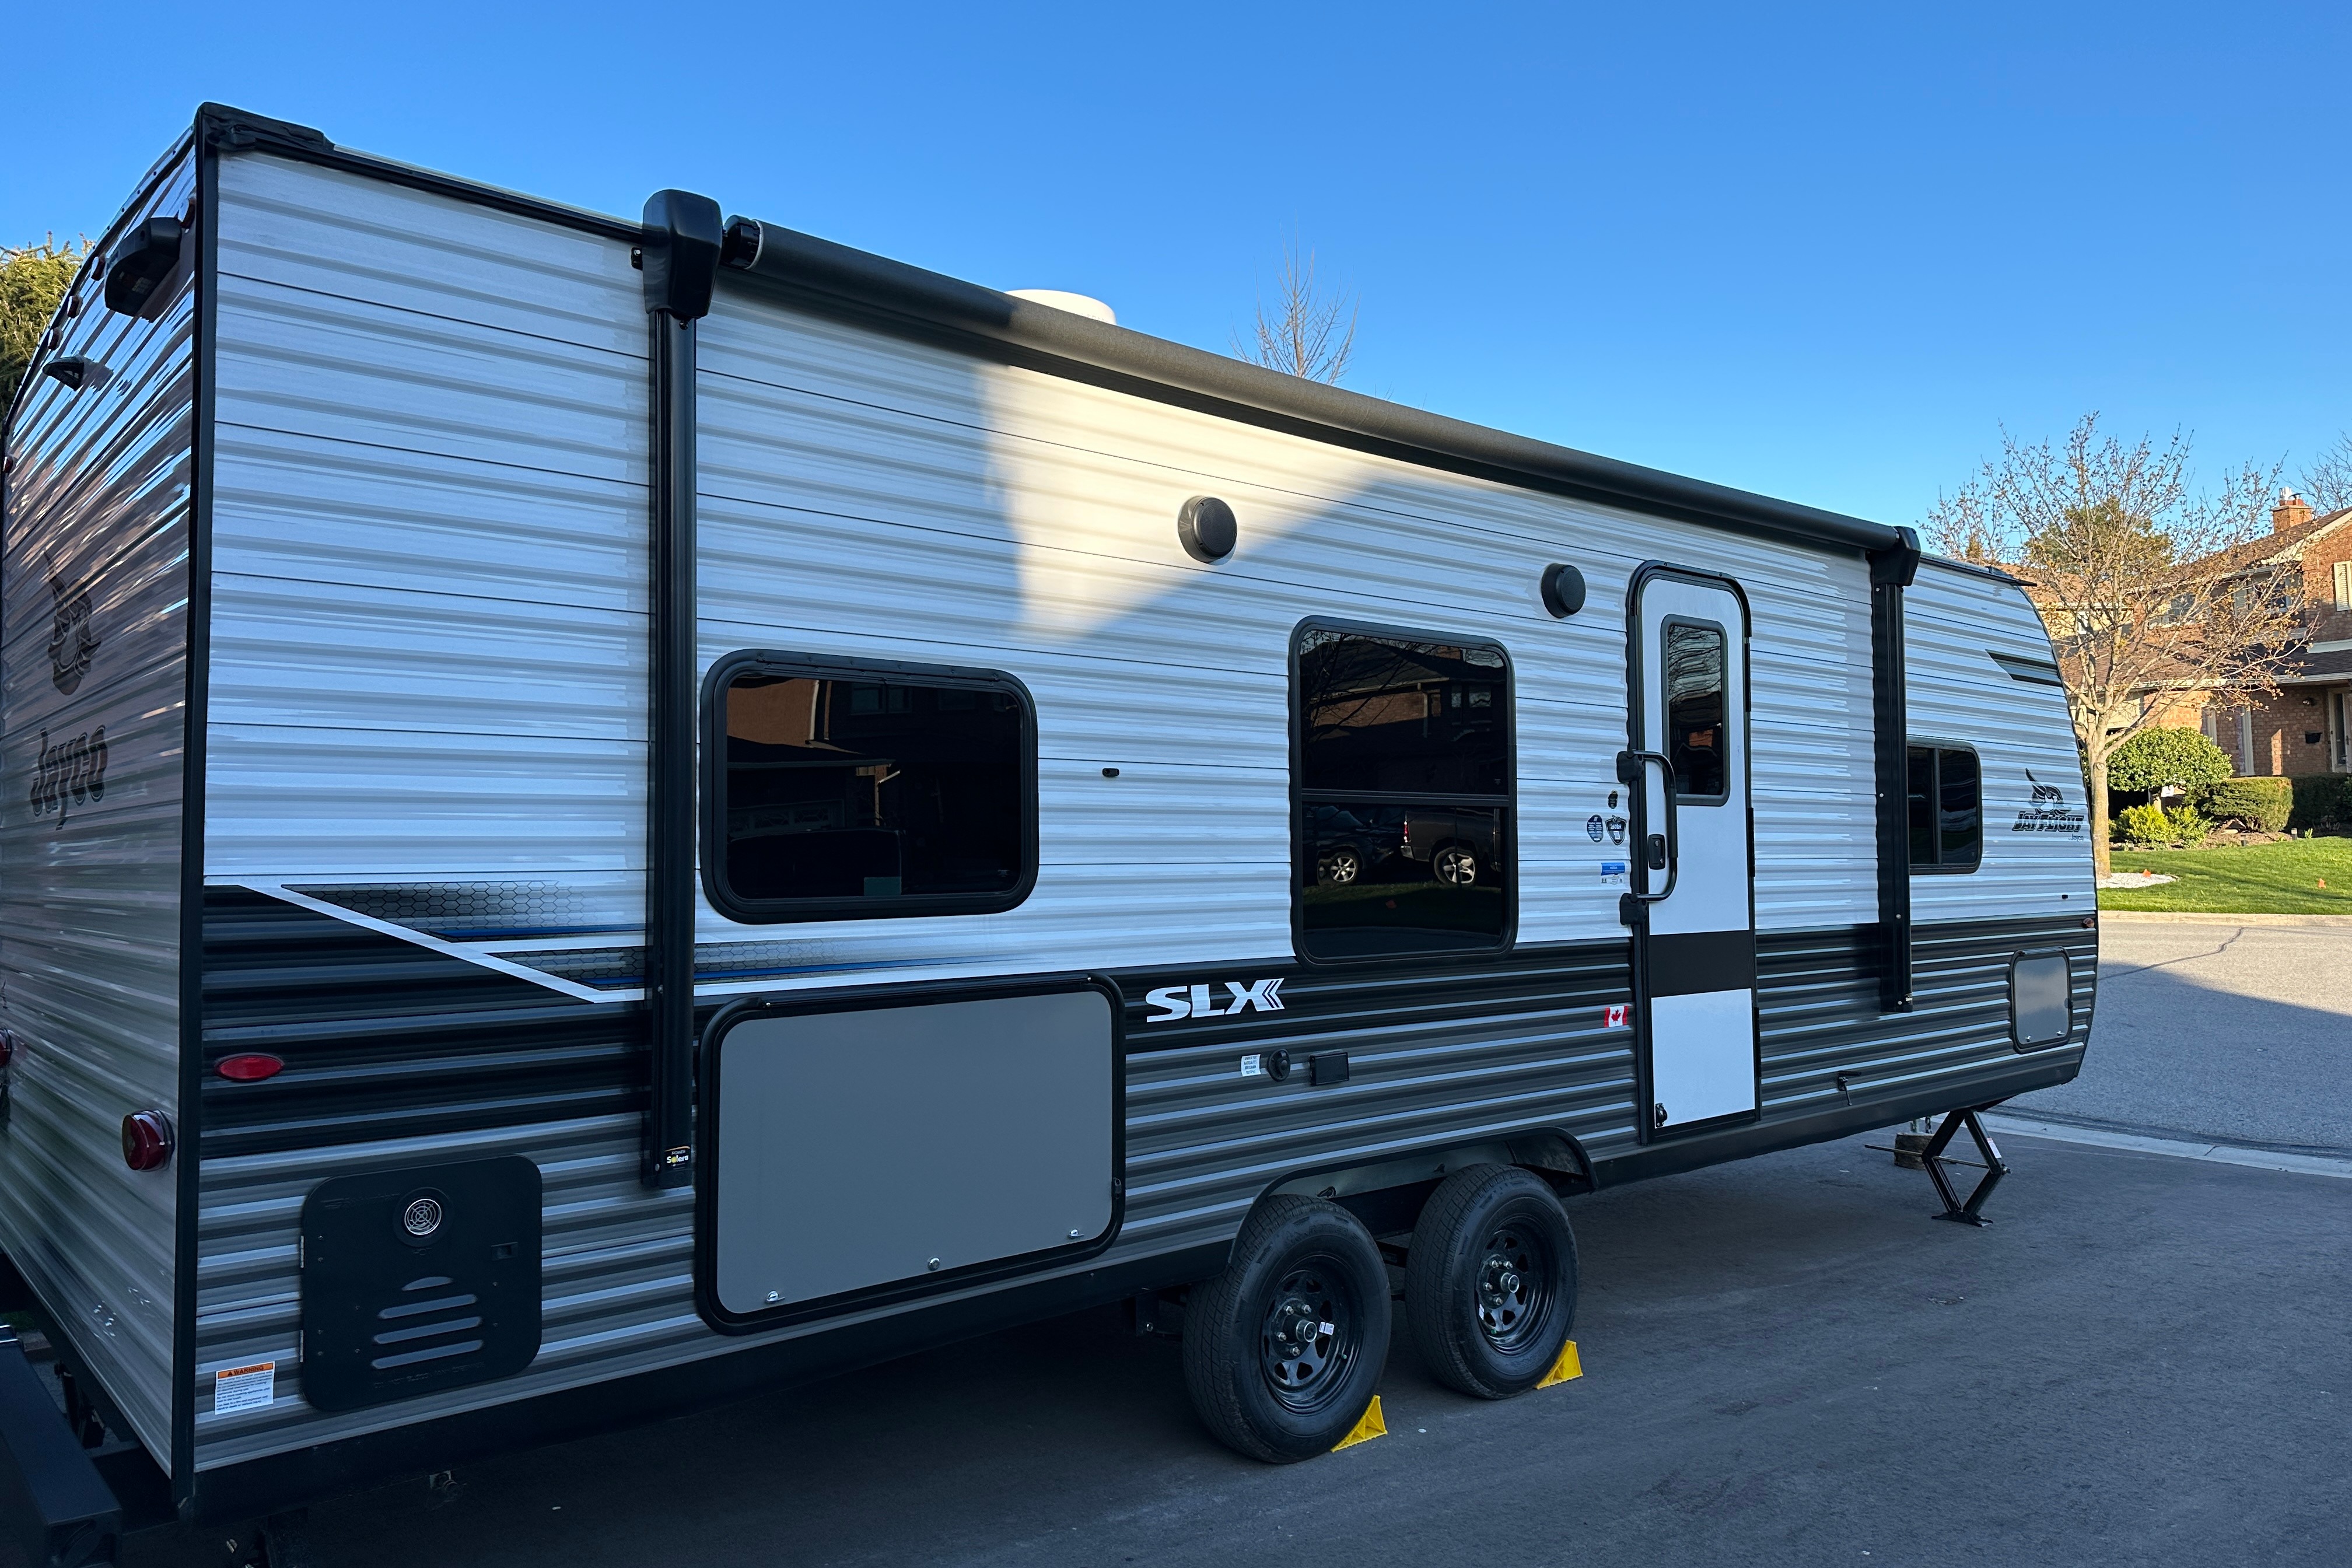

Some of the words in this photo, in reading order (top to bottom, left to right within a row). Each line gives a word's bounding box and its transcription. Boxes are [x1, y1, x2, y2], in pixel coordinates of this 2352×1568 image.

[30, 724, 108, 831] Jayco
[2012, 811, 2041, 832] JAY
[2036, 813, 2085, 833] FLIGHT
[1145, 978, 1285, 1023] SLX
[666, 1154, 689, 1164] Solera
[234, 1365, 264, 1376] WARNING
